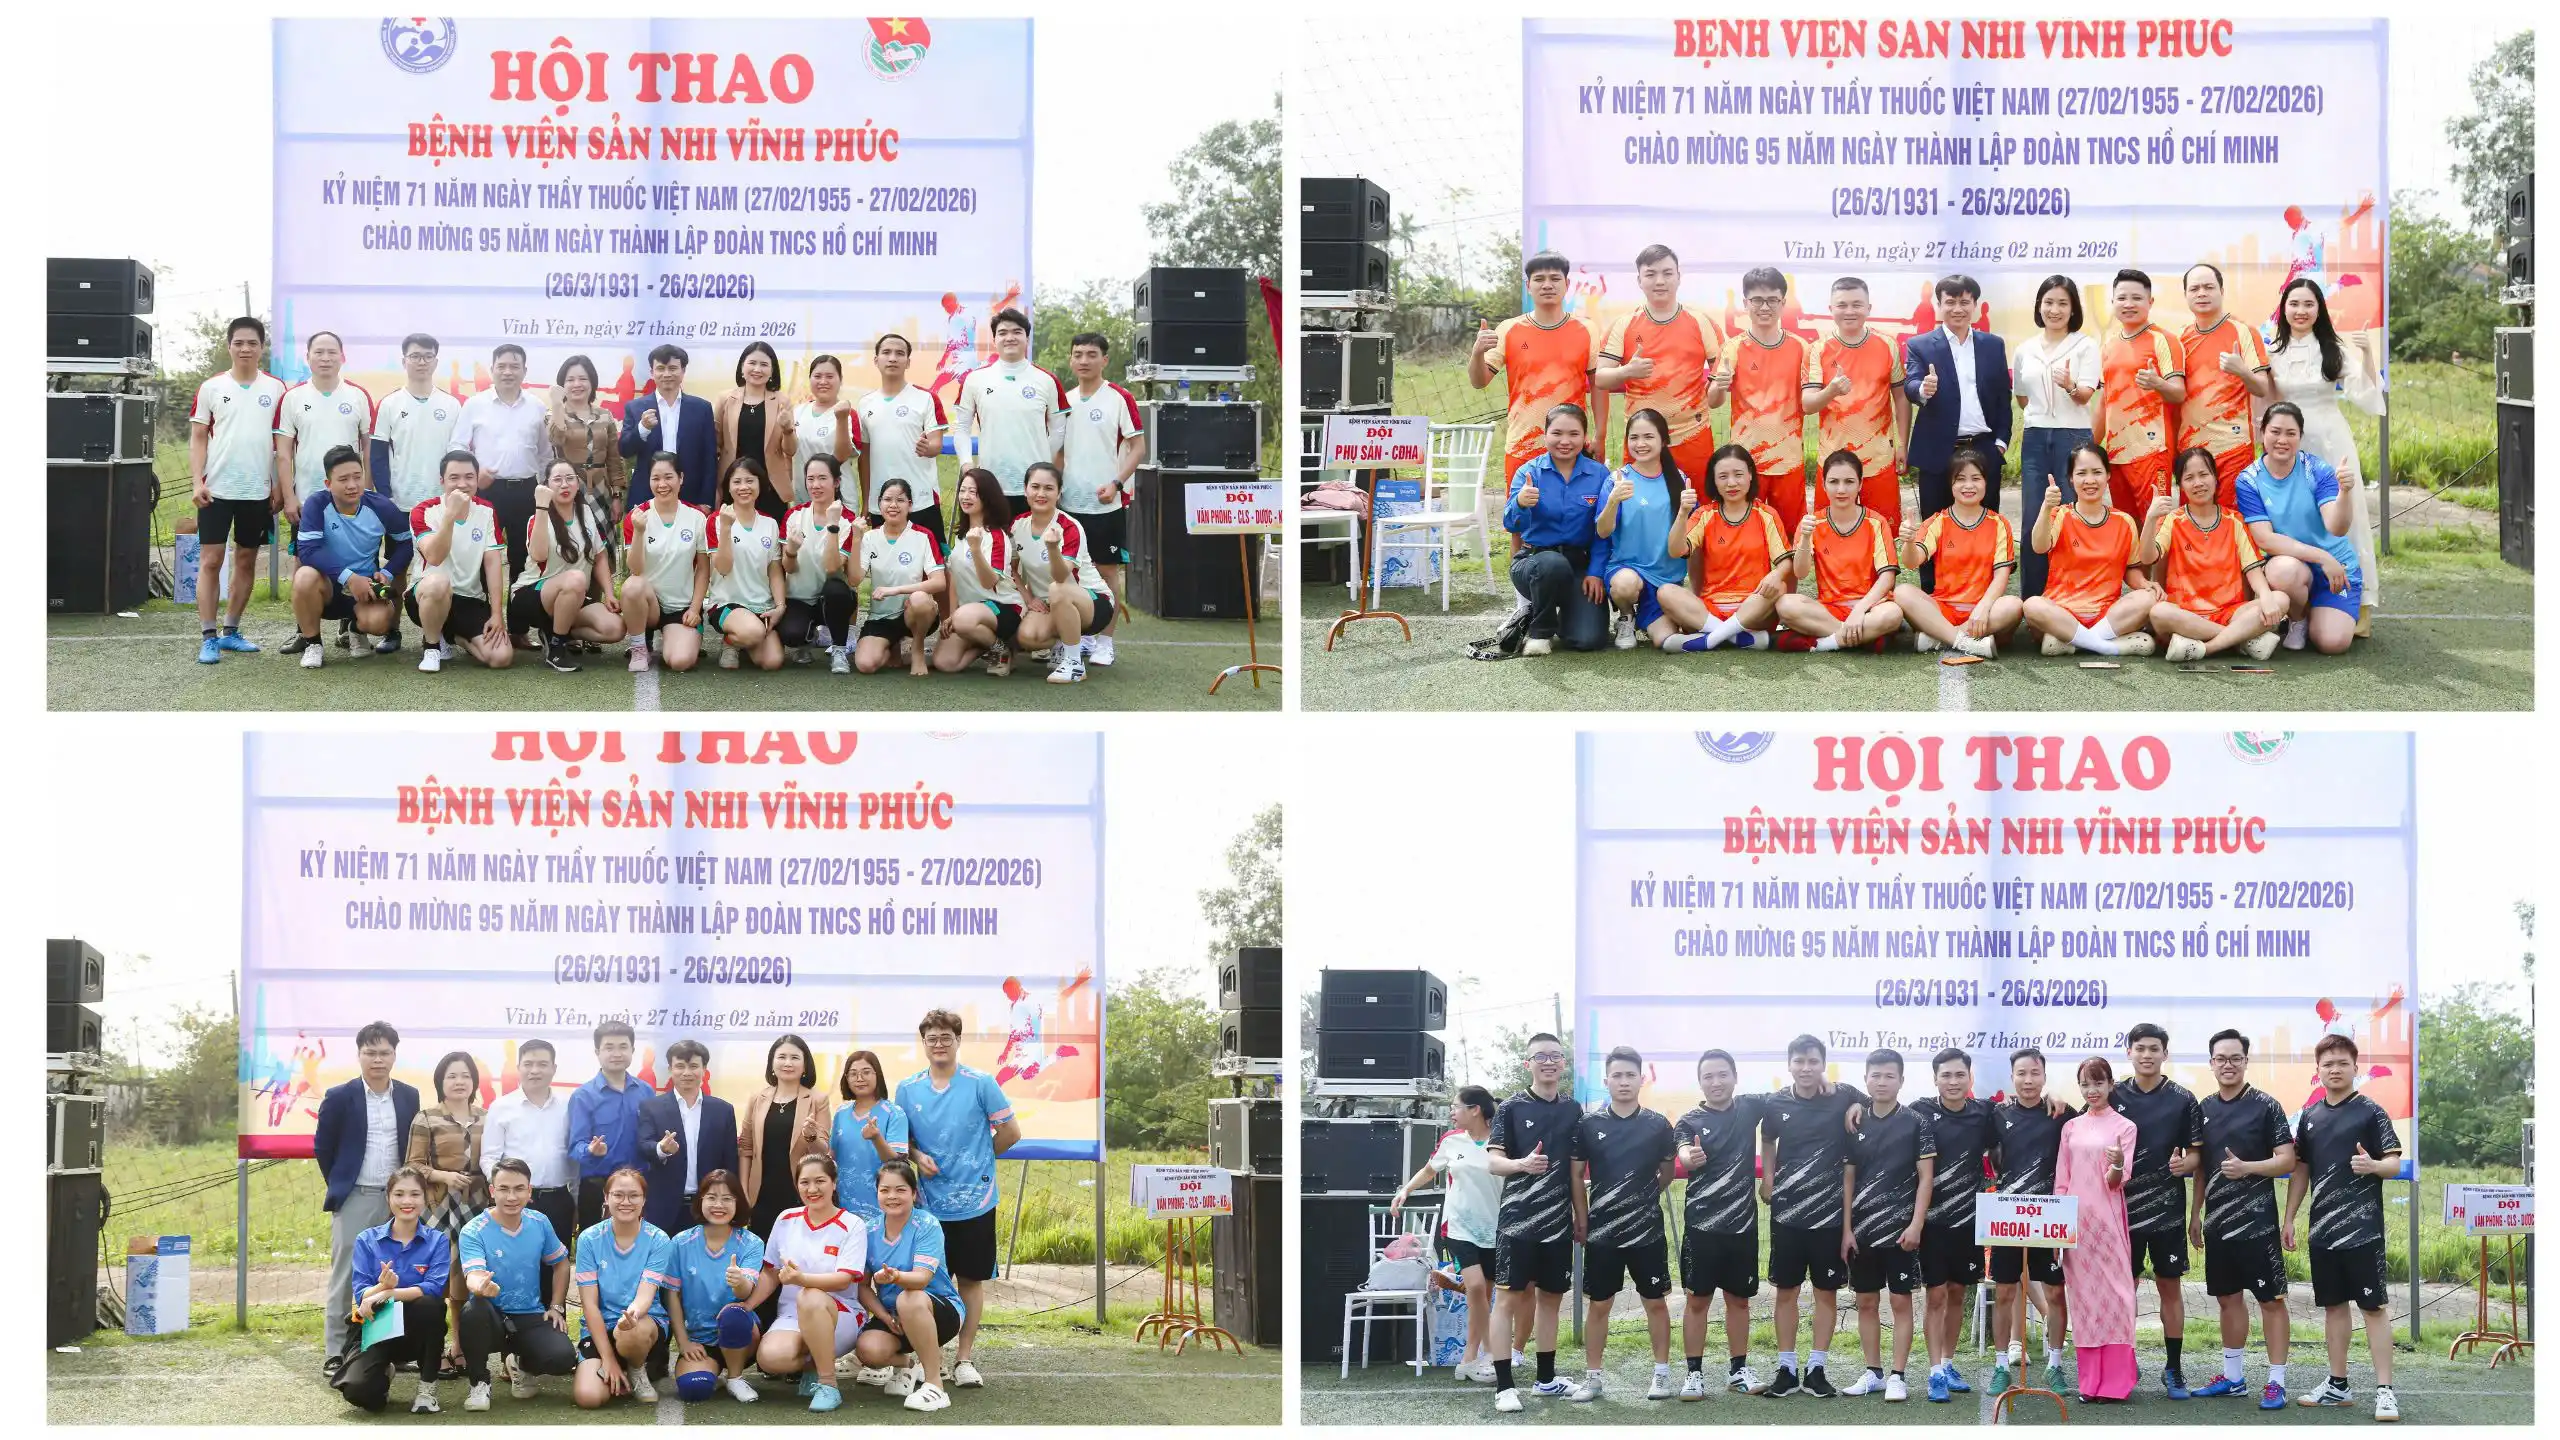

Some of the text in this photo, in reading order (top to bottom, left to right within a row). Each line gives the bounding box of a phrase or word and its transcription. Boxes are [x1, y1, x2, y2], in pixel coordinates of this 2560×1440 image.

[490, 36, 609, 117] HỘI
[628, 52, 814, 104] THAO
[1580, 76, 2323, 122] KỶ NIỆM 71 NĂM NGÀY THẦY THUỐC VIỆT NAM (27/02/1955 27/02/2026)
[408, 113, 900, 168] BỆNH VIỆN SẢN NHI VĨNH PHÚC
[1625, 128, 2278, 172] CHÀO MỪNG 95 NĂM NGÀY THÀNH LẬP ĐOÀN TNCS HỒ CHÍ MINH
[323, 171, 976, 215] KỶ NIỆM 71 NĂM NGÀY THẦY THUỐC VIỆT NAM (27/02/1955 27/02/2026)
[1832, 187, 2070, 218] (26/3/1931 26/3/2026)
[363, 221, 937, 260] CHÀO MỪNG 95 NĂM NGÀY THÀNH LẬP ĐOÀN TNCS HỒ CHÍ MINH
[1784, 240, 2118, 262] Vĩnh Yên, ngày 27 tháng 02 năm 2026
[545, 272, 755, 301] (26/3/1931 26/3/2026)
[502, 319, 796, 339] Vĩnh Yên, ngày 27 tháng 02 năm 2026
[1366, 425, 1393, 440] ĐỘI
[1335, 440, 1418, 463] PHỤ SẢN CĐHA
[1226, 491, 1254, 504] ĐỘI
[1238, 510, 1249, 524] CLS
[1965, 736, 2171, 791] THAO
[397, 774, 956, 838] BỆNH VIỆN SẢN NHI VĨNH PHÚC
[1723, 802, 2268, 865] BỆNH VIỆN SẢN NHI VĨNH PHÚC
[301, 840, 1041, 891] KỶ NIỆM 71 NĂM NGÀY THẦY THUỐC VIỆT NAM (27/02/1955 27/02/2026)
[1631, 871, 2353, 916] KỶ NIỆM 71 NĂM NGÀY THẦY THUỐC VIỆT NAM (27/02/1955 27/02/2026)
[1675, 921, 2310, 964] CHÀO MỪNG 95 NĂM NGÀY THÀNH LẬP ĐOÀN TNCS HỒ CHÍ MINH
[554, 955, 792, 988] (26/3/1931 26/3/2026)
[1876, 979, 2108, 1009] (26/3/1931 26/3/2026)
[1180, 1180, 1202, 1192] ĐỘI
[1189, 1195, 1198, 1209] CLS
[2016, 1203, 2042, 1218] ĐỘI
[1990, 1221, 2068, 1240] NGOẠI LCK
